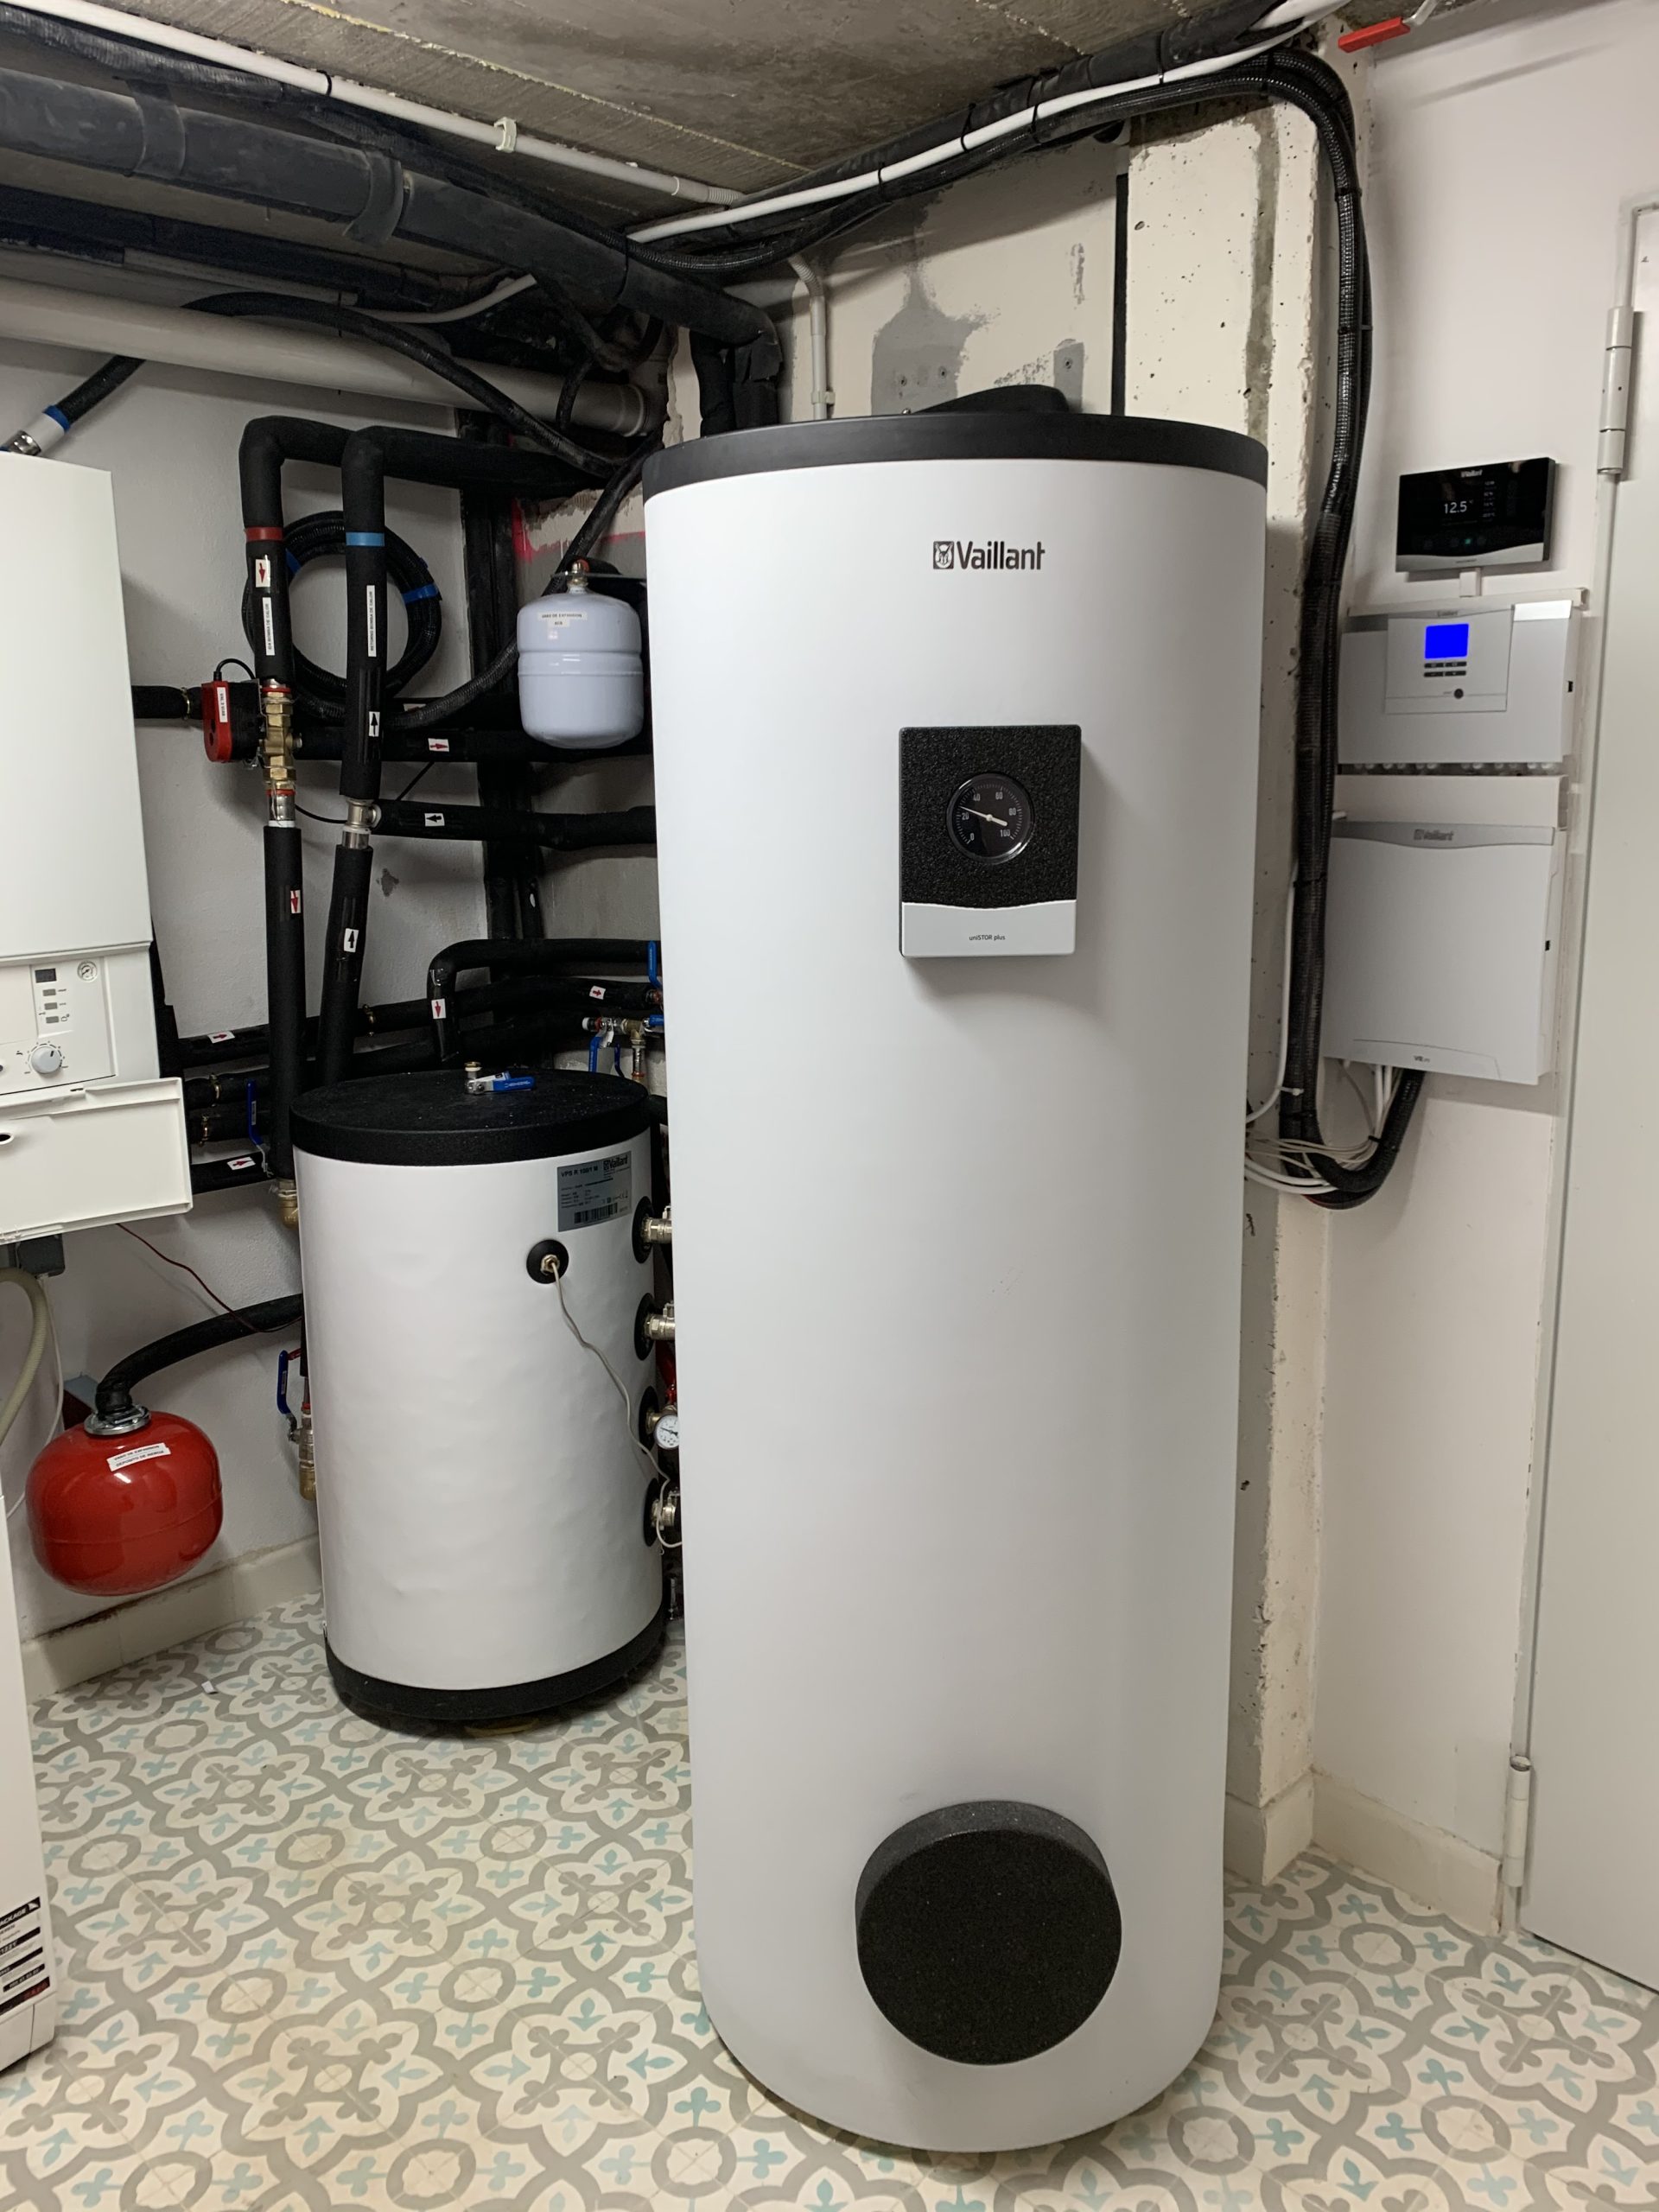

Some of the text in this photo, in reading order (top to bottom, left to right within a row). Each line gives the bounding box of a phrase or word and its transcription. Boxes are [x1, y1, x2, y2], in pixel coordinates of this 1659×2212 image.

[1444, 500, 1467, 514] 12.5
[957, 540, 1046, 570] Vaillant
[973, 793, 981, 802] 40
[995, 791, 1003, 800] 60
[1008, 807, 1017, 816] 80
[961, 812, 969, 821] 20
[969, 832, 975, 841] 0
[1000, 829, 1011, 837] 100
